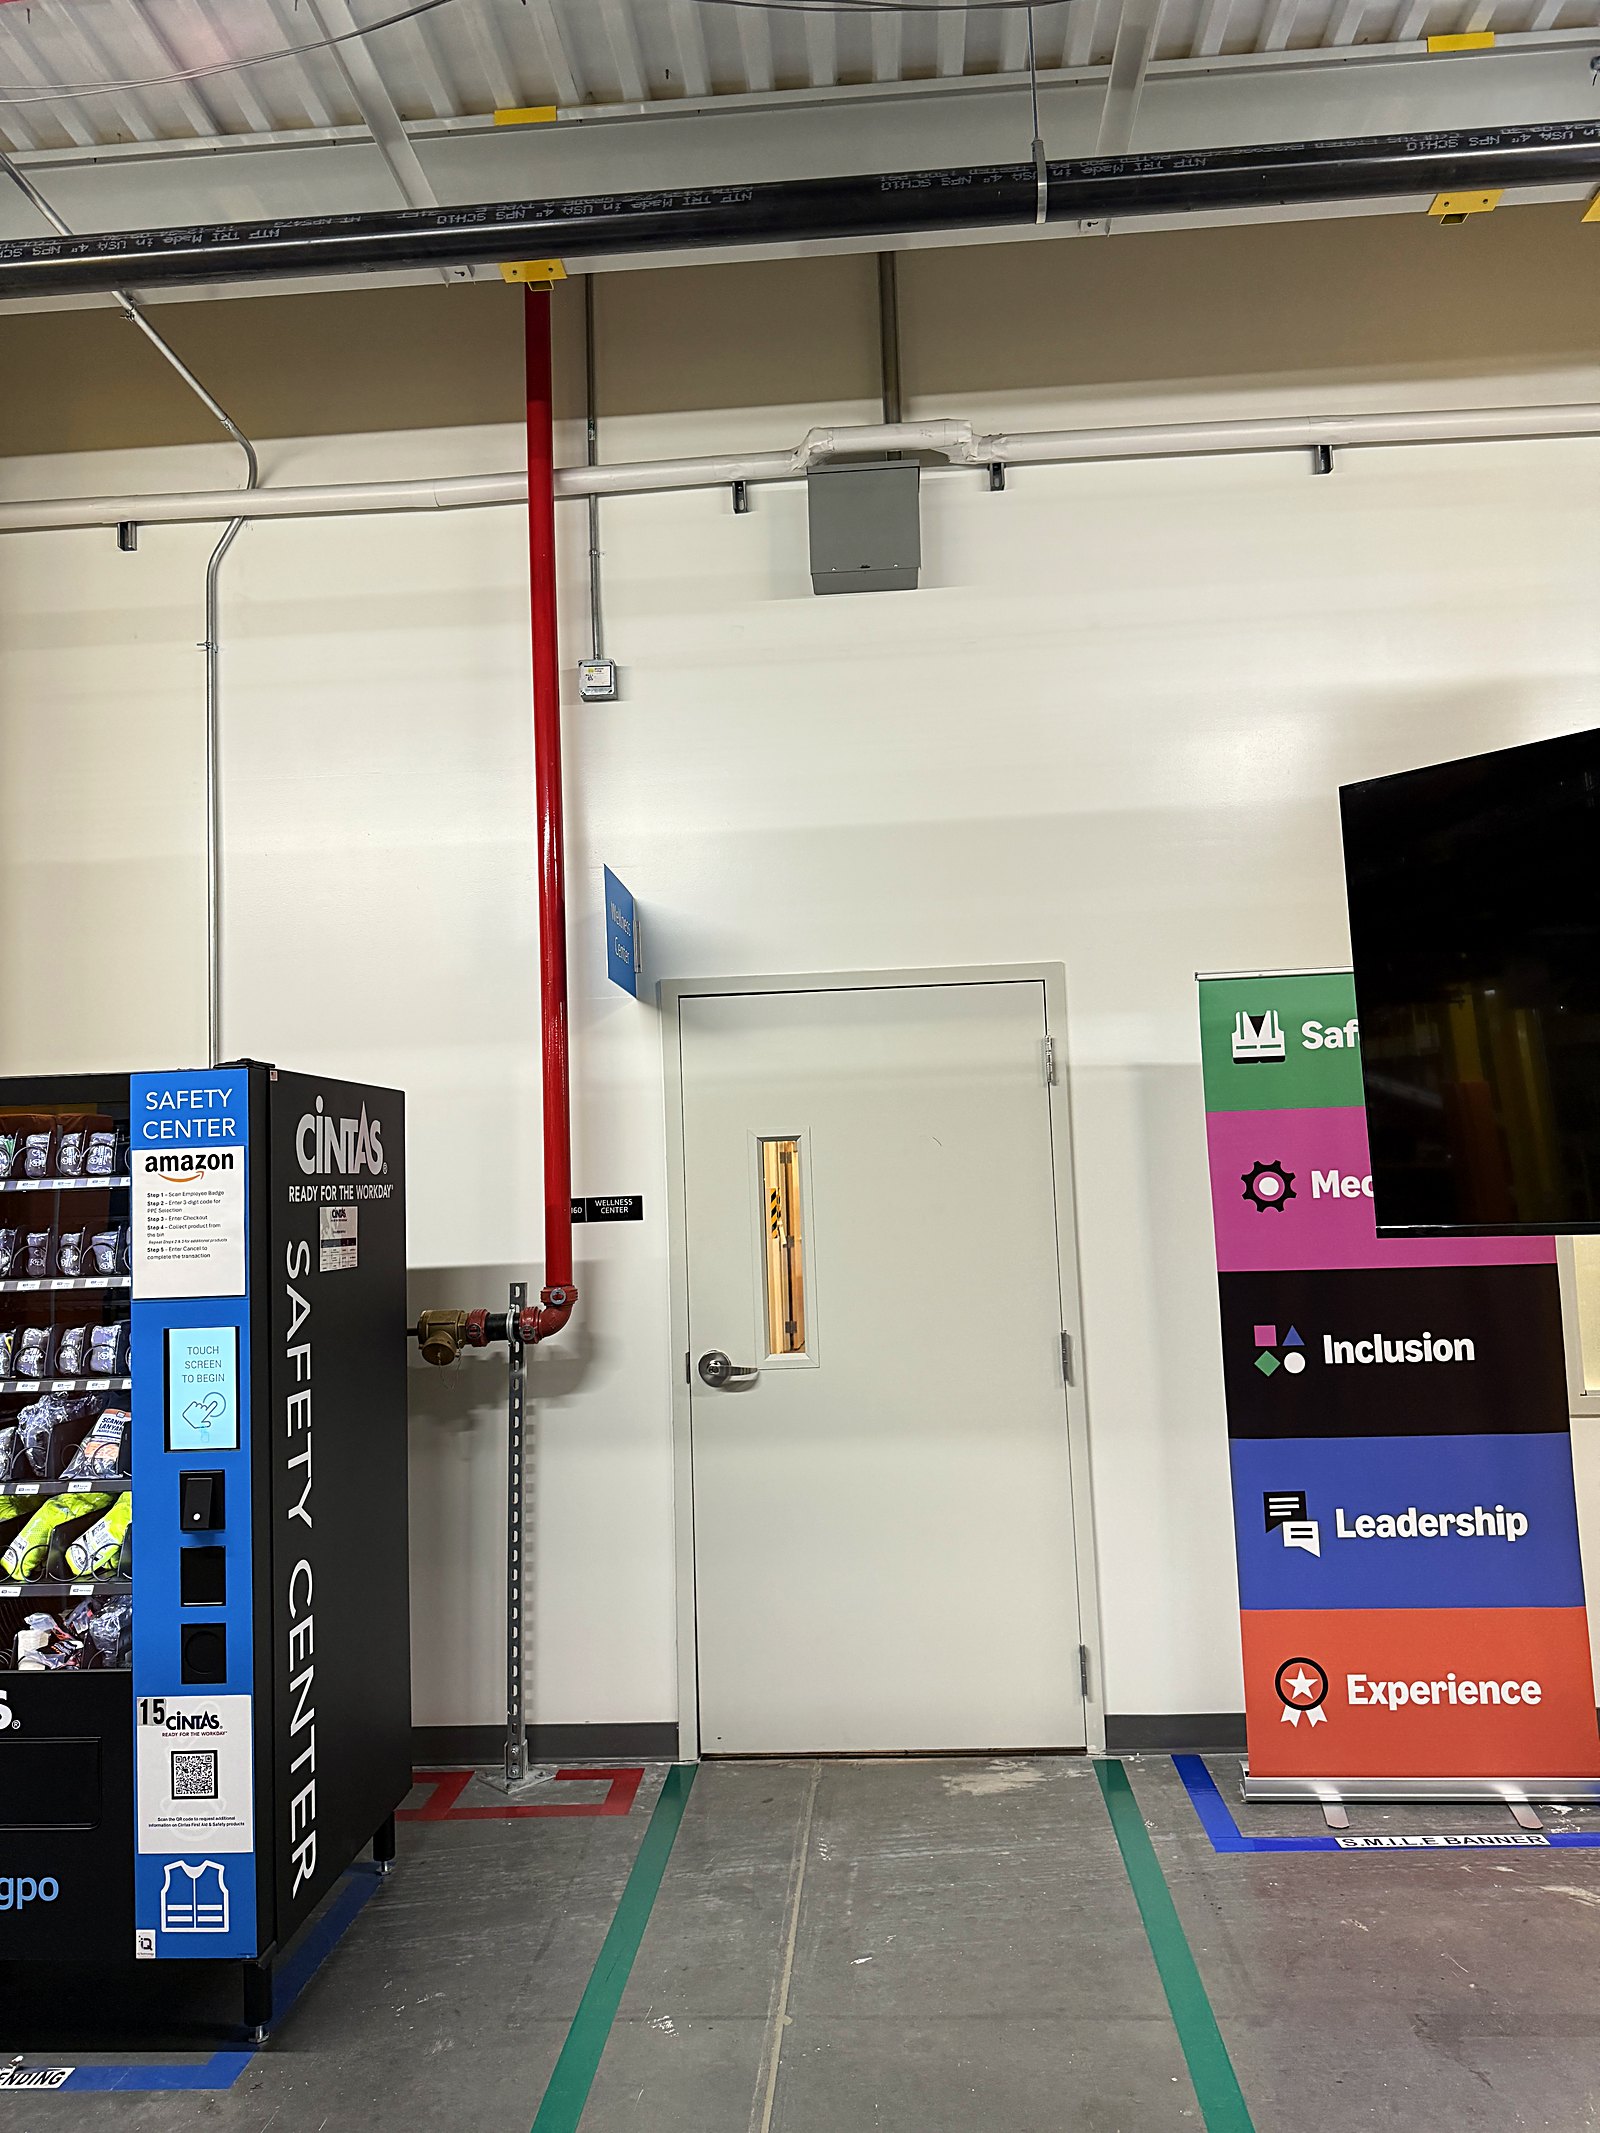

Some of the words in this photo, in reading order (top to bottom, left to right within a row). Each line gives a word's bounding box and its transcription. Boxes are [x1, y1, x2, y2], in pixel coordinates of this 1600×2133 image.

[1469, 135, 1499, 146] NPS
[1539, 130, 1573, 141] USA
[1134, 161, 1163, 171] TRI
[1173, 158, 1206, 168] NTP
[1052, 169, 1071, 178] in
[1081, 164, 1123, 176] Made
[941, 176, 971, 186] NPS
[682, 196, 711, 206] TRI
[720, 192, 752, 203] NTP
[561, 204, 593, 215] USA
[603, 203, 621, 212] in
[631, 199, 672, 210] Made
[496, 210, 525, 220] NPS
[211, 231, 239, 241] TRI
[248, 228, 280, 239] NTP
[97, 240, 126, 250] USA
[136, 238, 153, 247] in
[163, 234, 202, 245] Made
[32, 245, 61, 256] NPS
[1301, 1019, 1360, 1049] Saf
[146, 1088, 232, 1111] SAFETY
[142, 1118, 236, 1139] CENTER
[145, 1152, 234, 1173] amazon
[289, 1186, 318, 1202] READY
[321, 1185, 337, 1200] FOR
[339, 1185, 354, 1200] THE
[187, 1346, 219, 1356] TOUCH
[1323, 1332, 1476, 1364] Inclusion
[184, 1360, 222, 1369] SCREEN
[182, 1374, 194, 1383] TO
[196, 1373, 225, 1383] BEGIN
[286, 1240, 312, 1528] SAFETY
[1335, 1504, 1528, 1542] Leadership
[1347, 1672, 1542, 1710] Experience
[140, 1698, 165, 1725] 15
[288, 1559, 317, 1899] CENTER
[1344, 1838, 1439, 1847] S.M.I.L.E
[1443, 1836, 1544, 1845] BANNER
